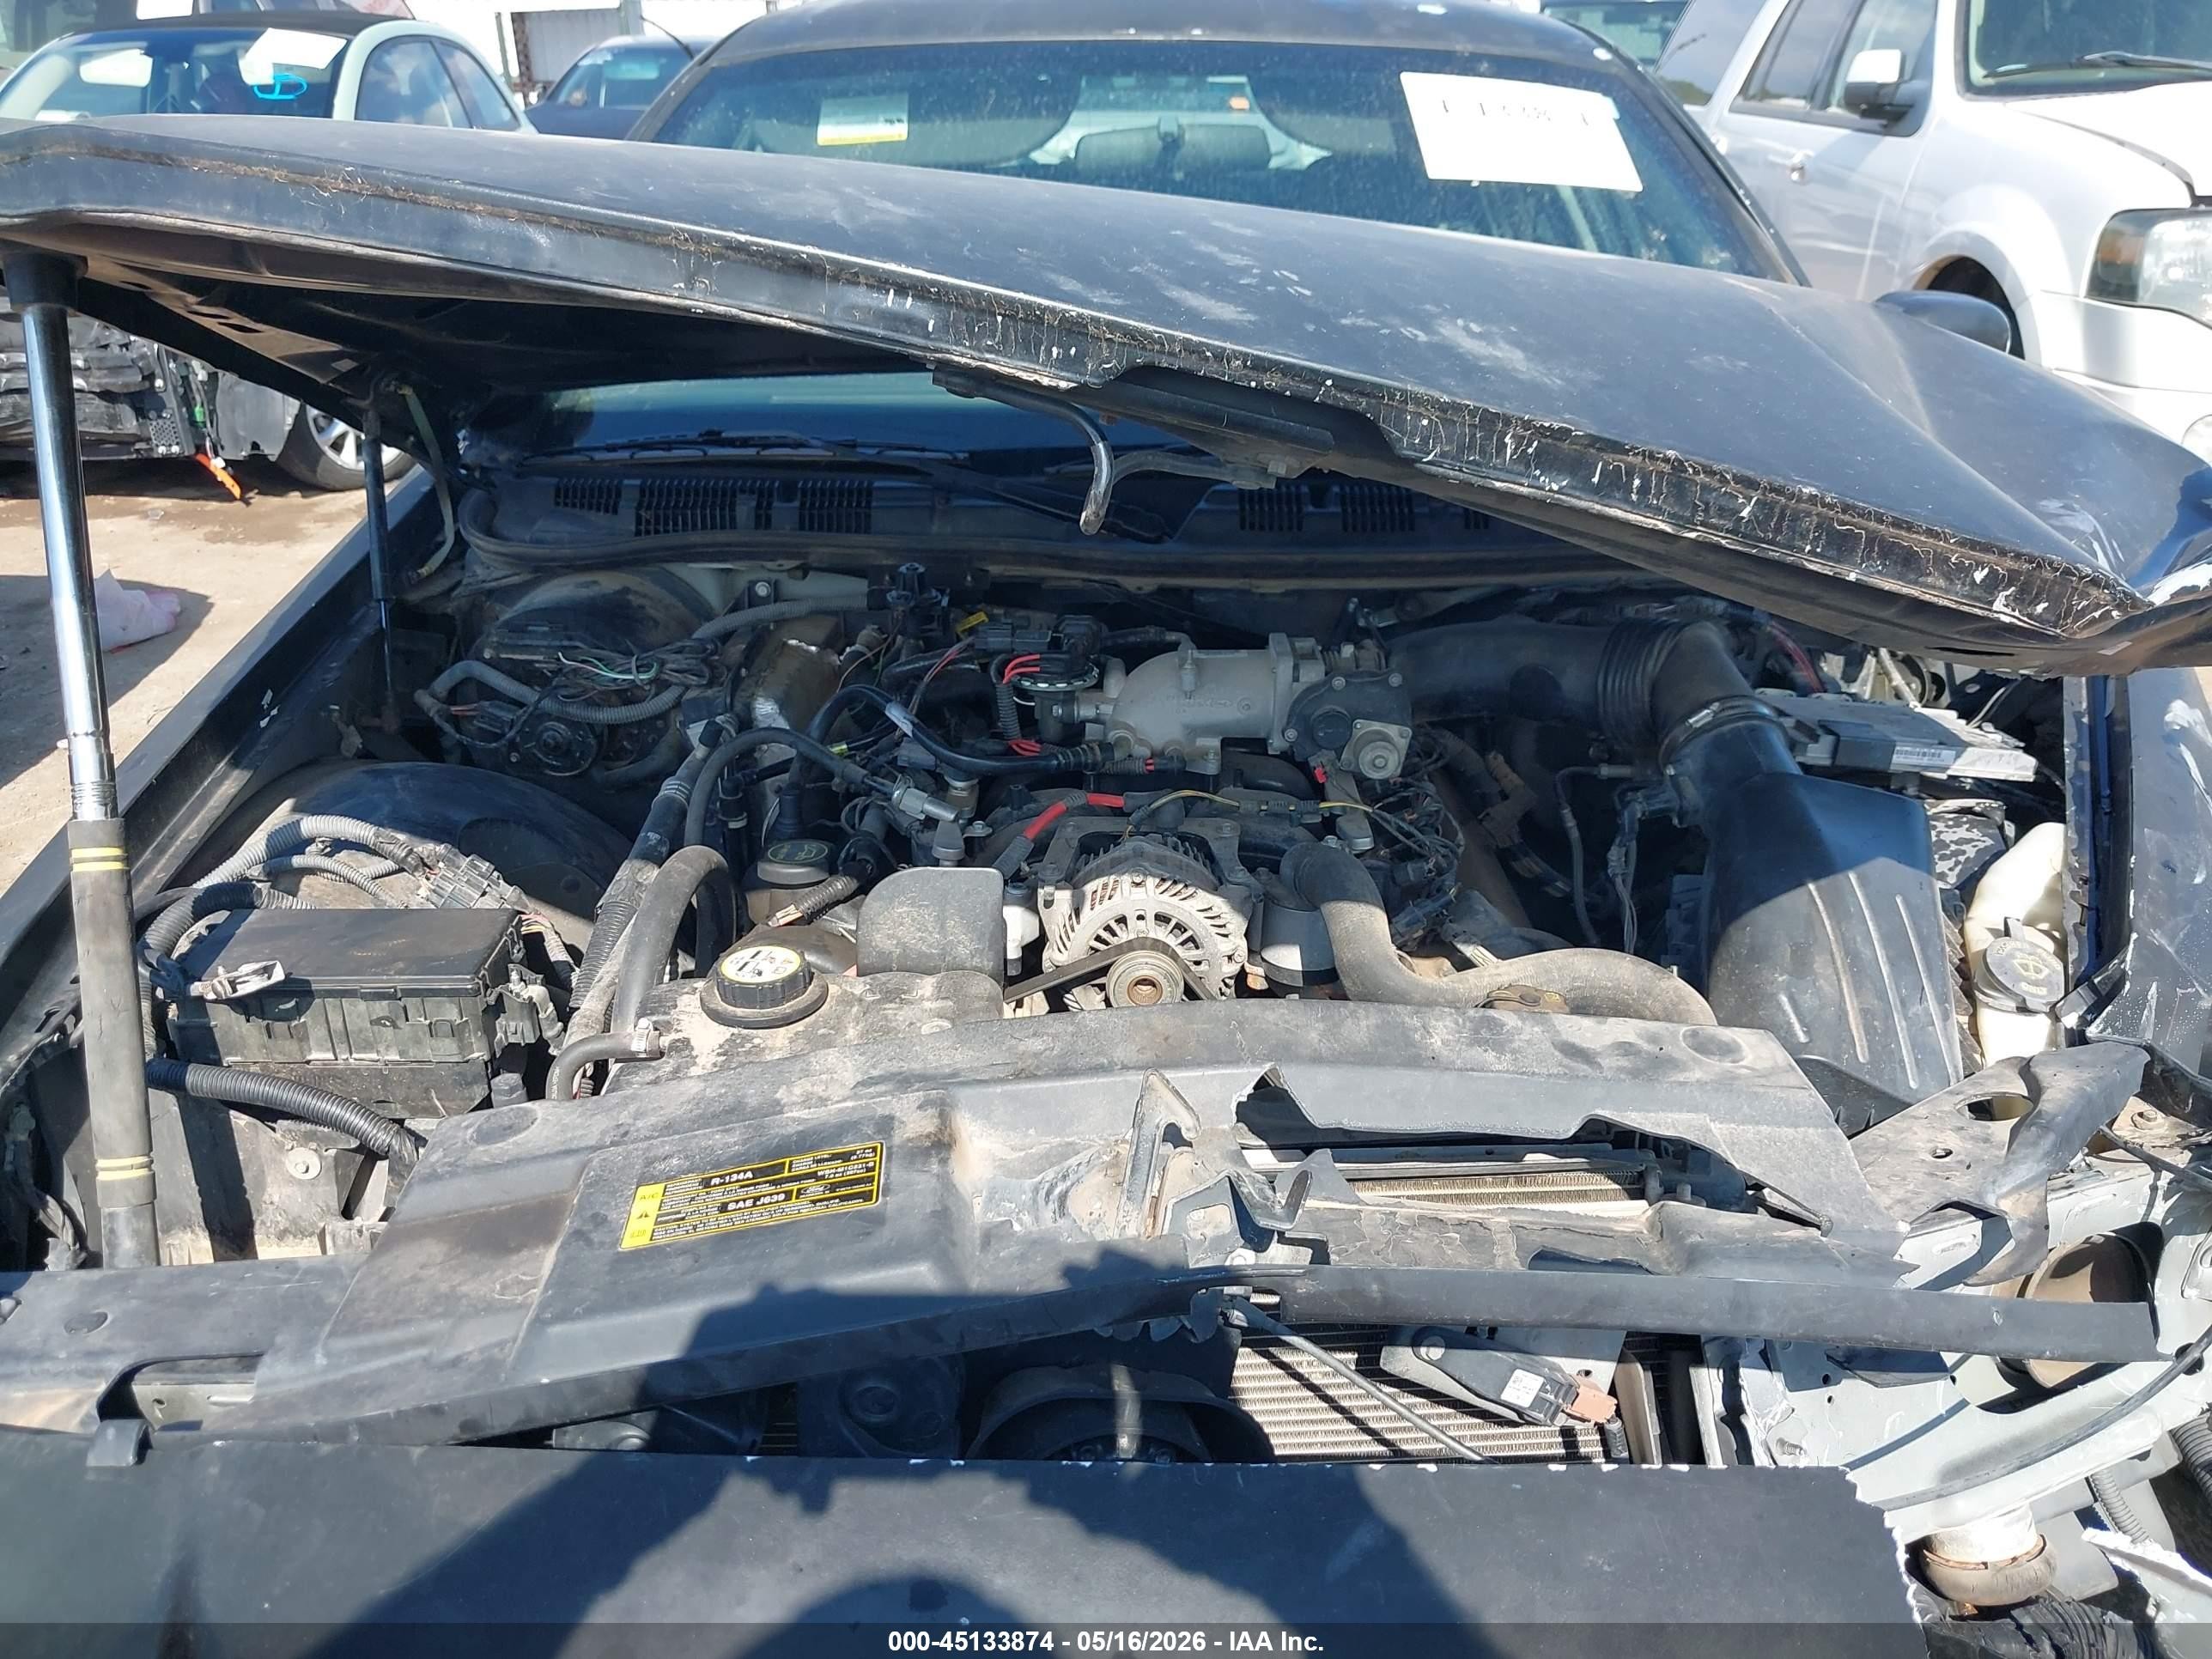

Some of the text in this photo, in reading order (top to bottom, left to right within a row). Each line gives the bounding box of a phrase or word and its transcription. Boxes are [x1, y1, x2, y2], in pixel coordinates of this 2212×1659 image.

[711, 1171, 753, 1185] R-134A
[727, 1200, 754, 1210] SAE
[756, 1194, 786, 1206] J639
